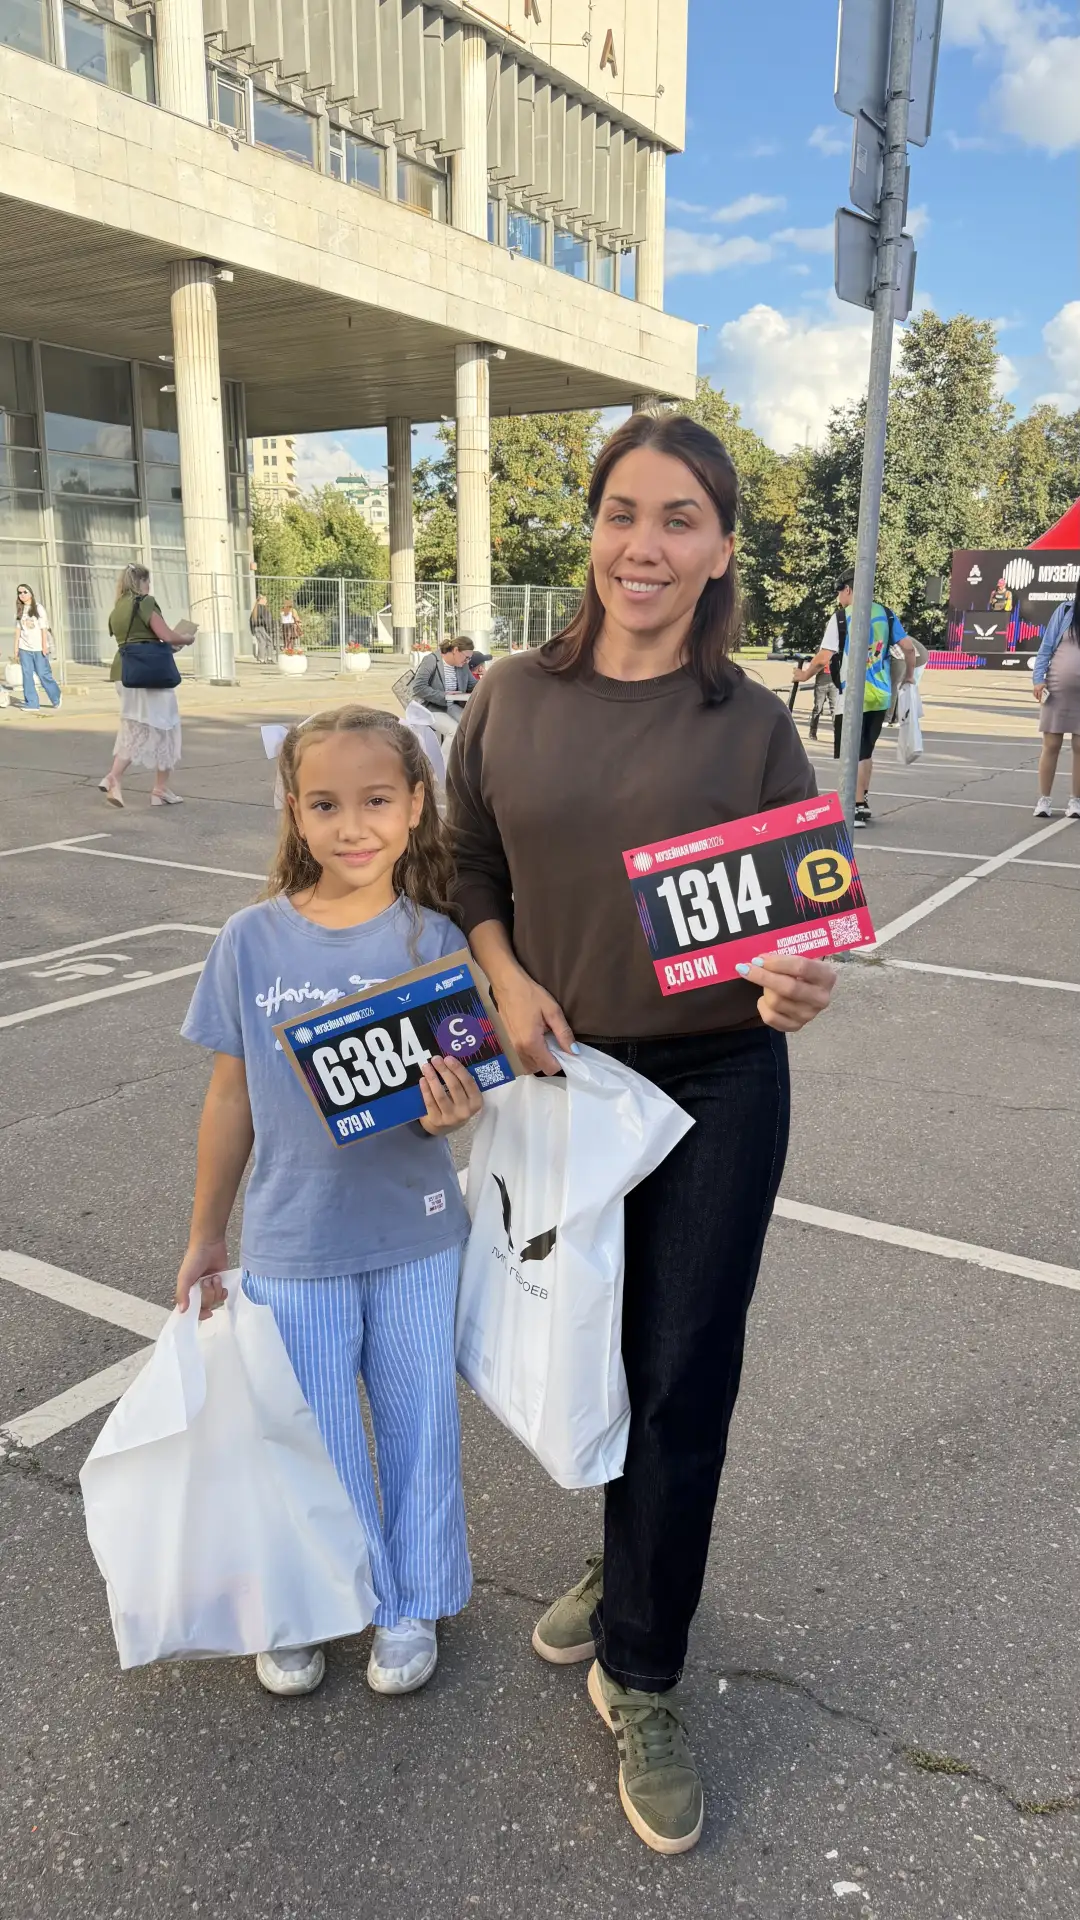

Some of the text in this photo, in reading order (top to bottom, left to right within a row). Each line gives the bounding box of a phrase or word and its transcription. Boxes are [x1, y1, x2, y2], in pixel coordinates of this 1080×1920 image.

[654, 844, 690, 863] МУЗЕЙНАЯ
[806, 856, 844, 897] B
[656, 853, 772, 947] 1314
[776, 927, 827, 948] АУДИОСПЕКТАКЛЬ
[797, 937, 830, 954] ДВИЖЕНИЯ
[664, 955, 718, 986] 8,79 КМ
[313, 1016, 345, 1035] МУЗЕЙНАЯ
[451, 1034, 476, 1052] 6-9
[312, 1016, 432, 1106] 6384
[336, 1109, 376, 1137] 879 М
[491, 1246, 508, 1271] ЛИГ
